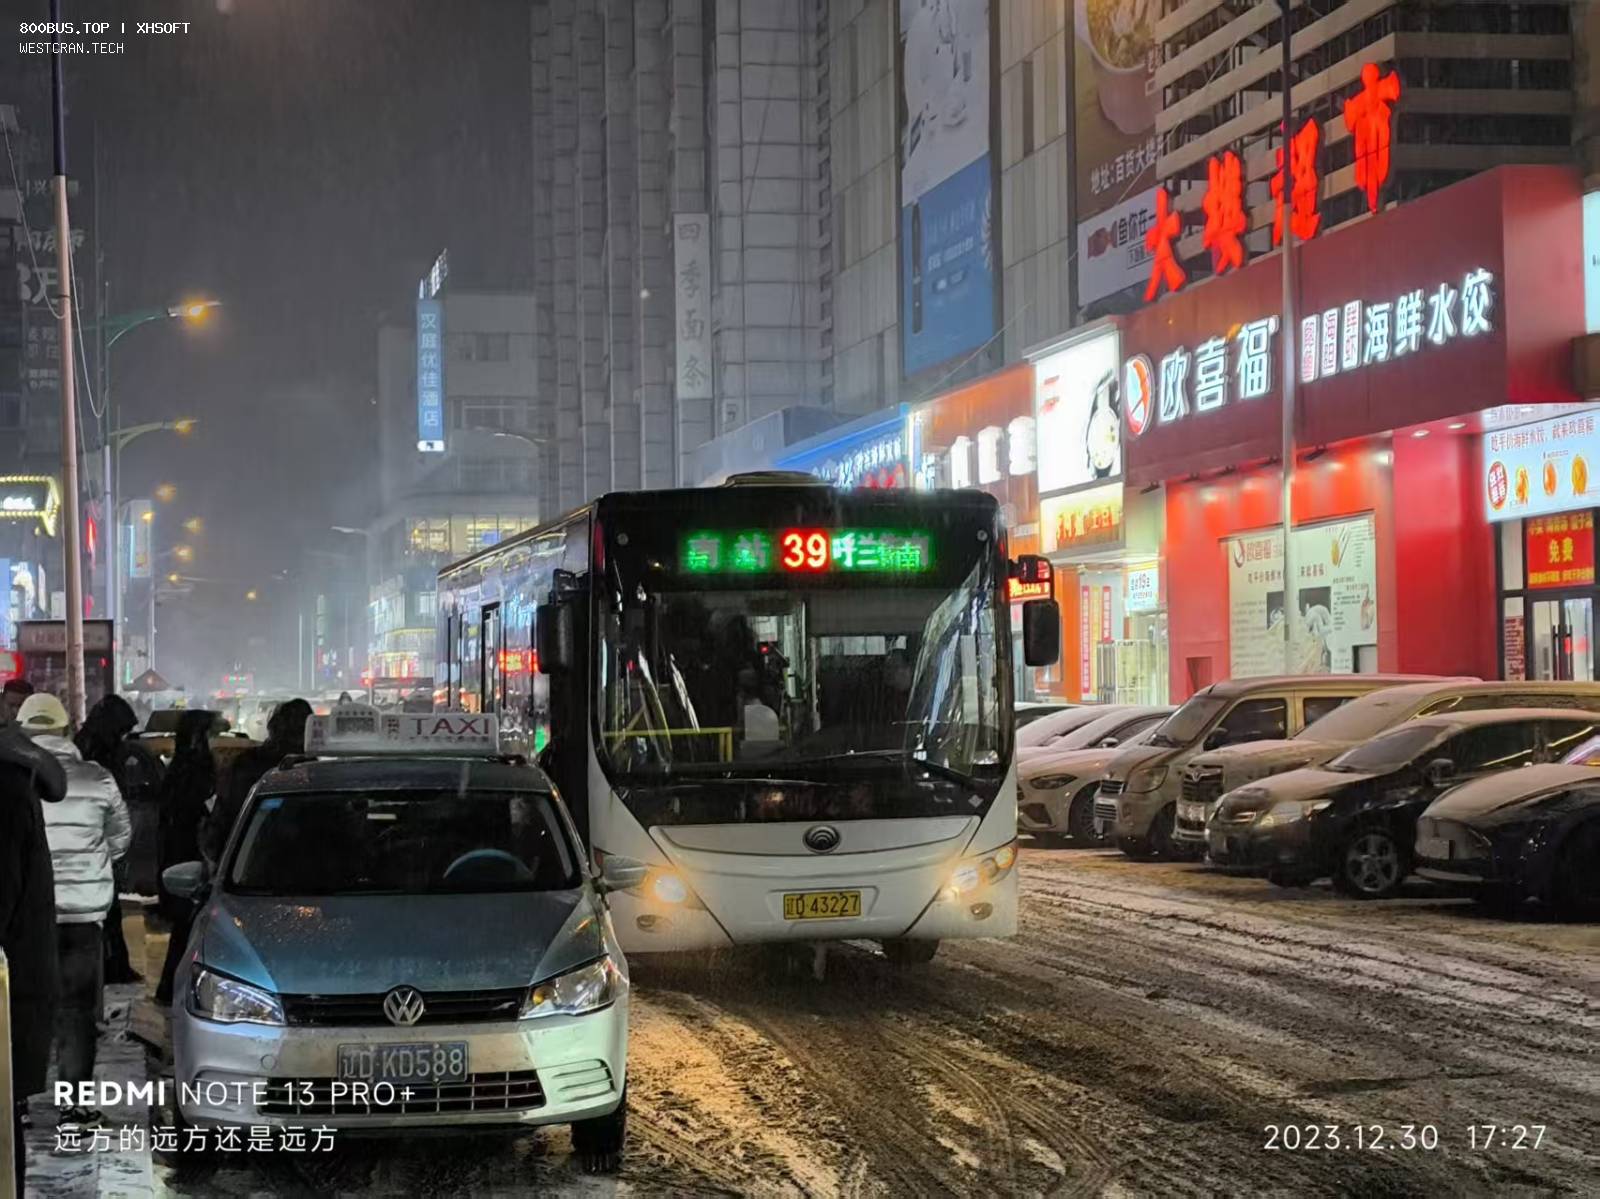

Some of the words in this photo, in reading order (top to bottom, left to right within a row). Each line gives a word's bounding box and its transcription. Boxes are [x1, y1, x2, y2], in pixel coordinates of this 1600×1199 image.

[678, 222, 708, 388] 四季面条
[1159, 317, 1273, 424] 欧喜福
[1363, 268, 1494, 365] 海鲜水饺
[783, 533, 828, 568] 39
[410, 717, 490, 736] TAXI
